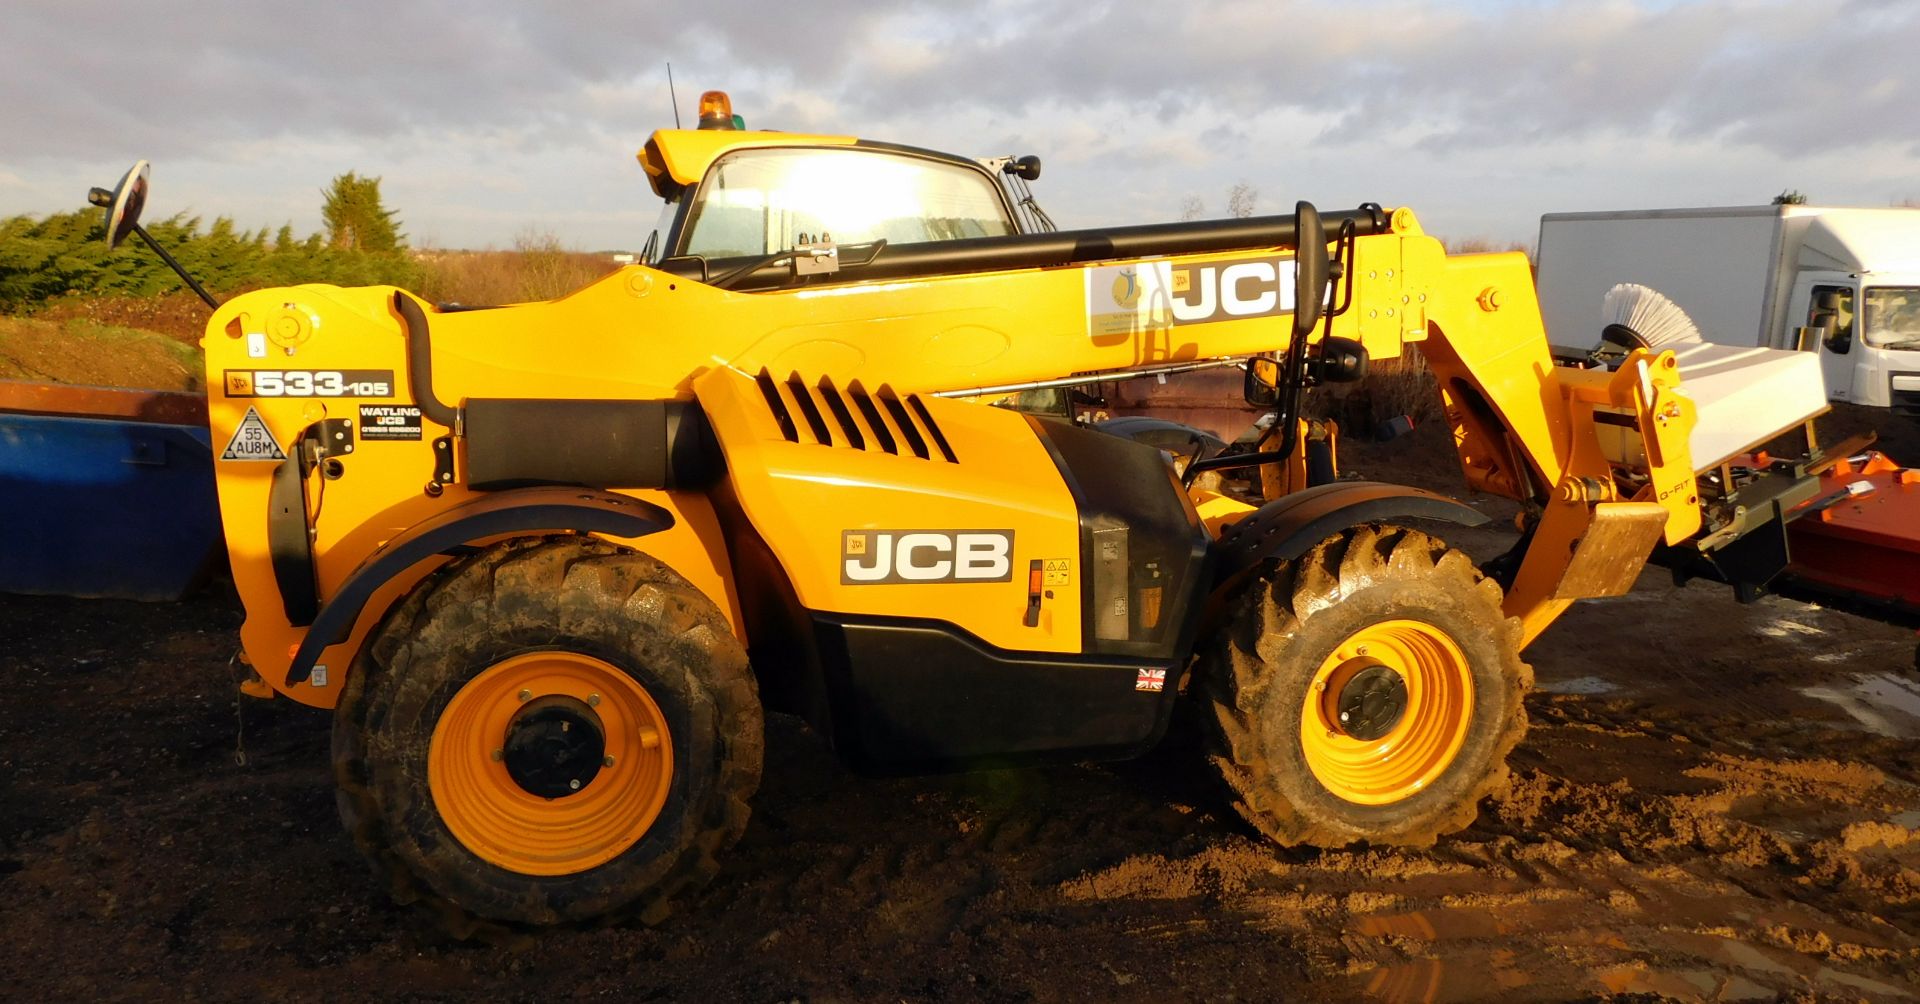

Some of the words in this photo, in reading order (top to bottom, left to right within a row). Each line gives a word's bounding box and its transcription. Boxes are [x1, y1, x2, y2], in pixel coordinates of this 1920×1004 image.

[255, 372, 388, 396] 533-105
[360, 407, 421, 416] WATLING
[376, 416, 405, 425] JCB
[245, 427, 262, 441] 55
[237, 441, 272, 454] AU8M
[845, 534, 1009, 580] JCB
